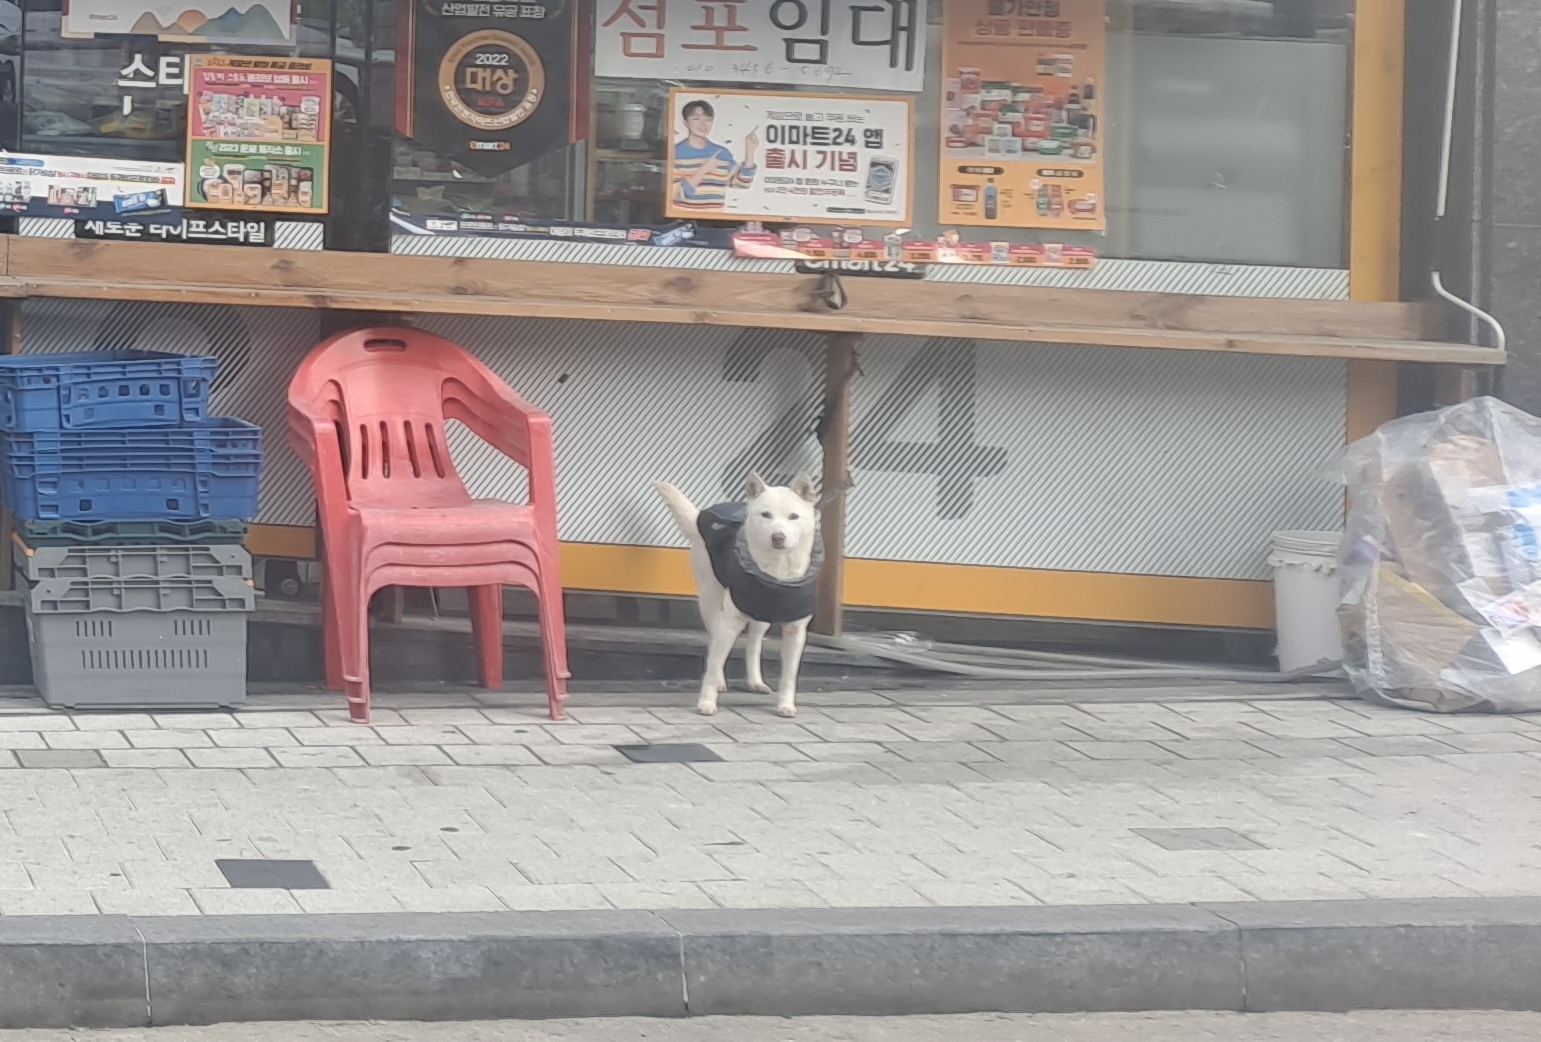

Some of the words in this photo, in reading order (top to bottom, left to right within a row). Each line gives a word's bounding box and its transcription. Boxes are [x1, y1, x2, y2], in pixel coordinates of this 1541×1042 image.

[441, 3, 490, 16] 산업발전
[492, 4, 517, 18] 유공
[973, 18, 1011, 37] 상품
[475, 53, 510, 66] 2022
[465, 67, 519, 95] 대상
[766, 124, 857, 147] 이마트24
[863, 128, 884, 149] 앱
[765, 148, 808, 170] 출시
[815, 149, 858, 173] 기념
